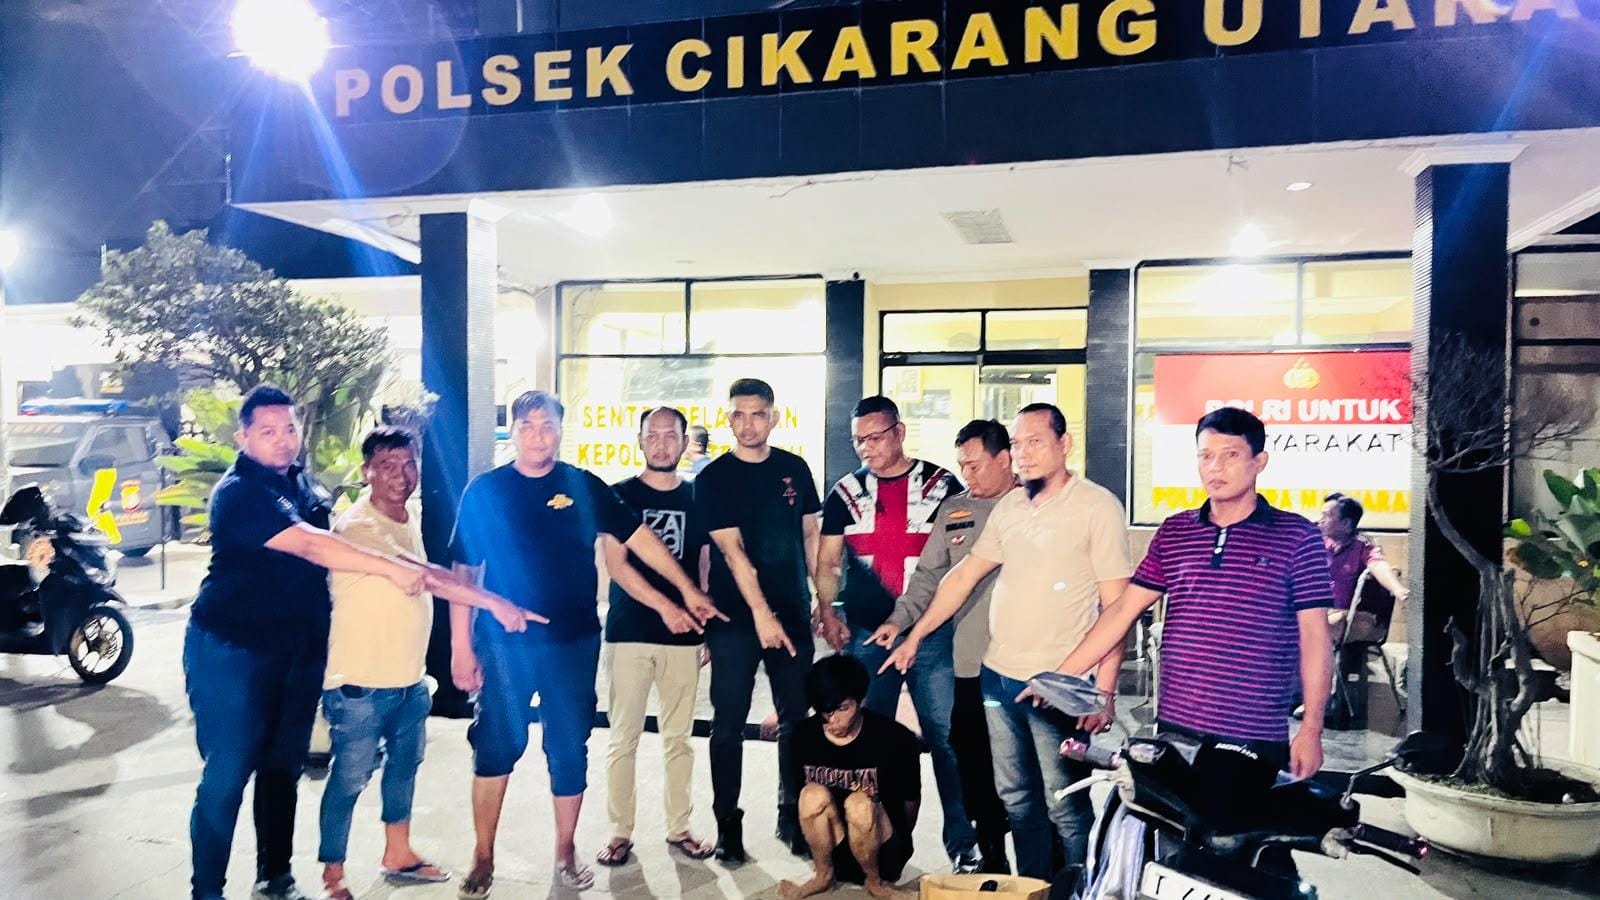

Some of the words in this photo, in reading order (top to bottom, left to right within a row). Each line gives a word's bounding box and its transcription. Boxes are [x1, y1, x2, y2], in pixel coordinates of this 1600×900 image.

[335, 44, 635, 118] POLSEK
[664, 0, 1158, 93] CIKARANG
[1299, 399, 1402, 421] UNTUK
[1266, 433, 1402, 452] YARAKAT
